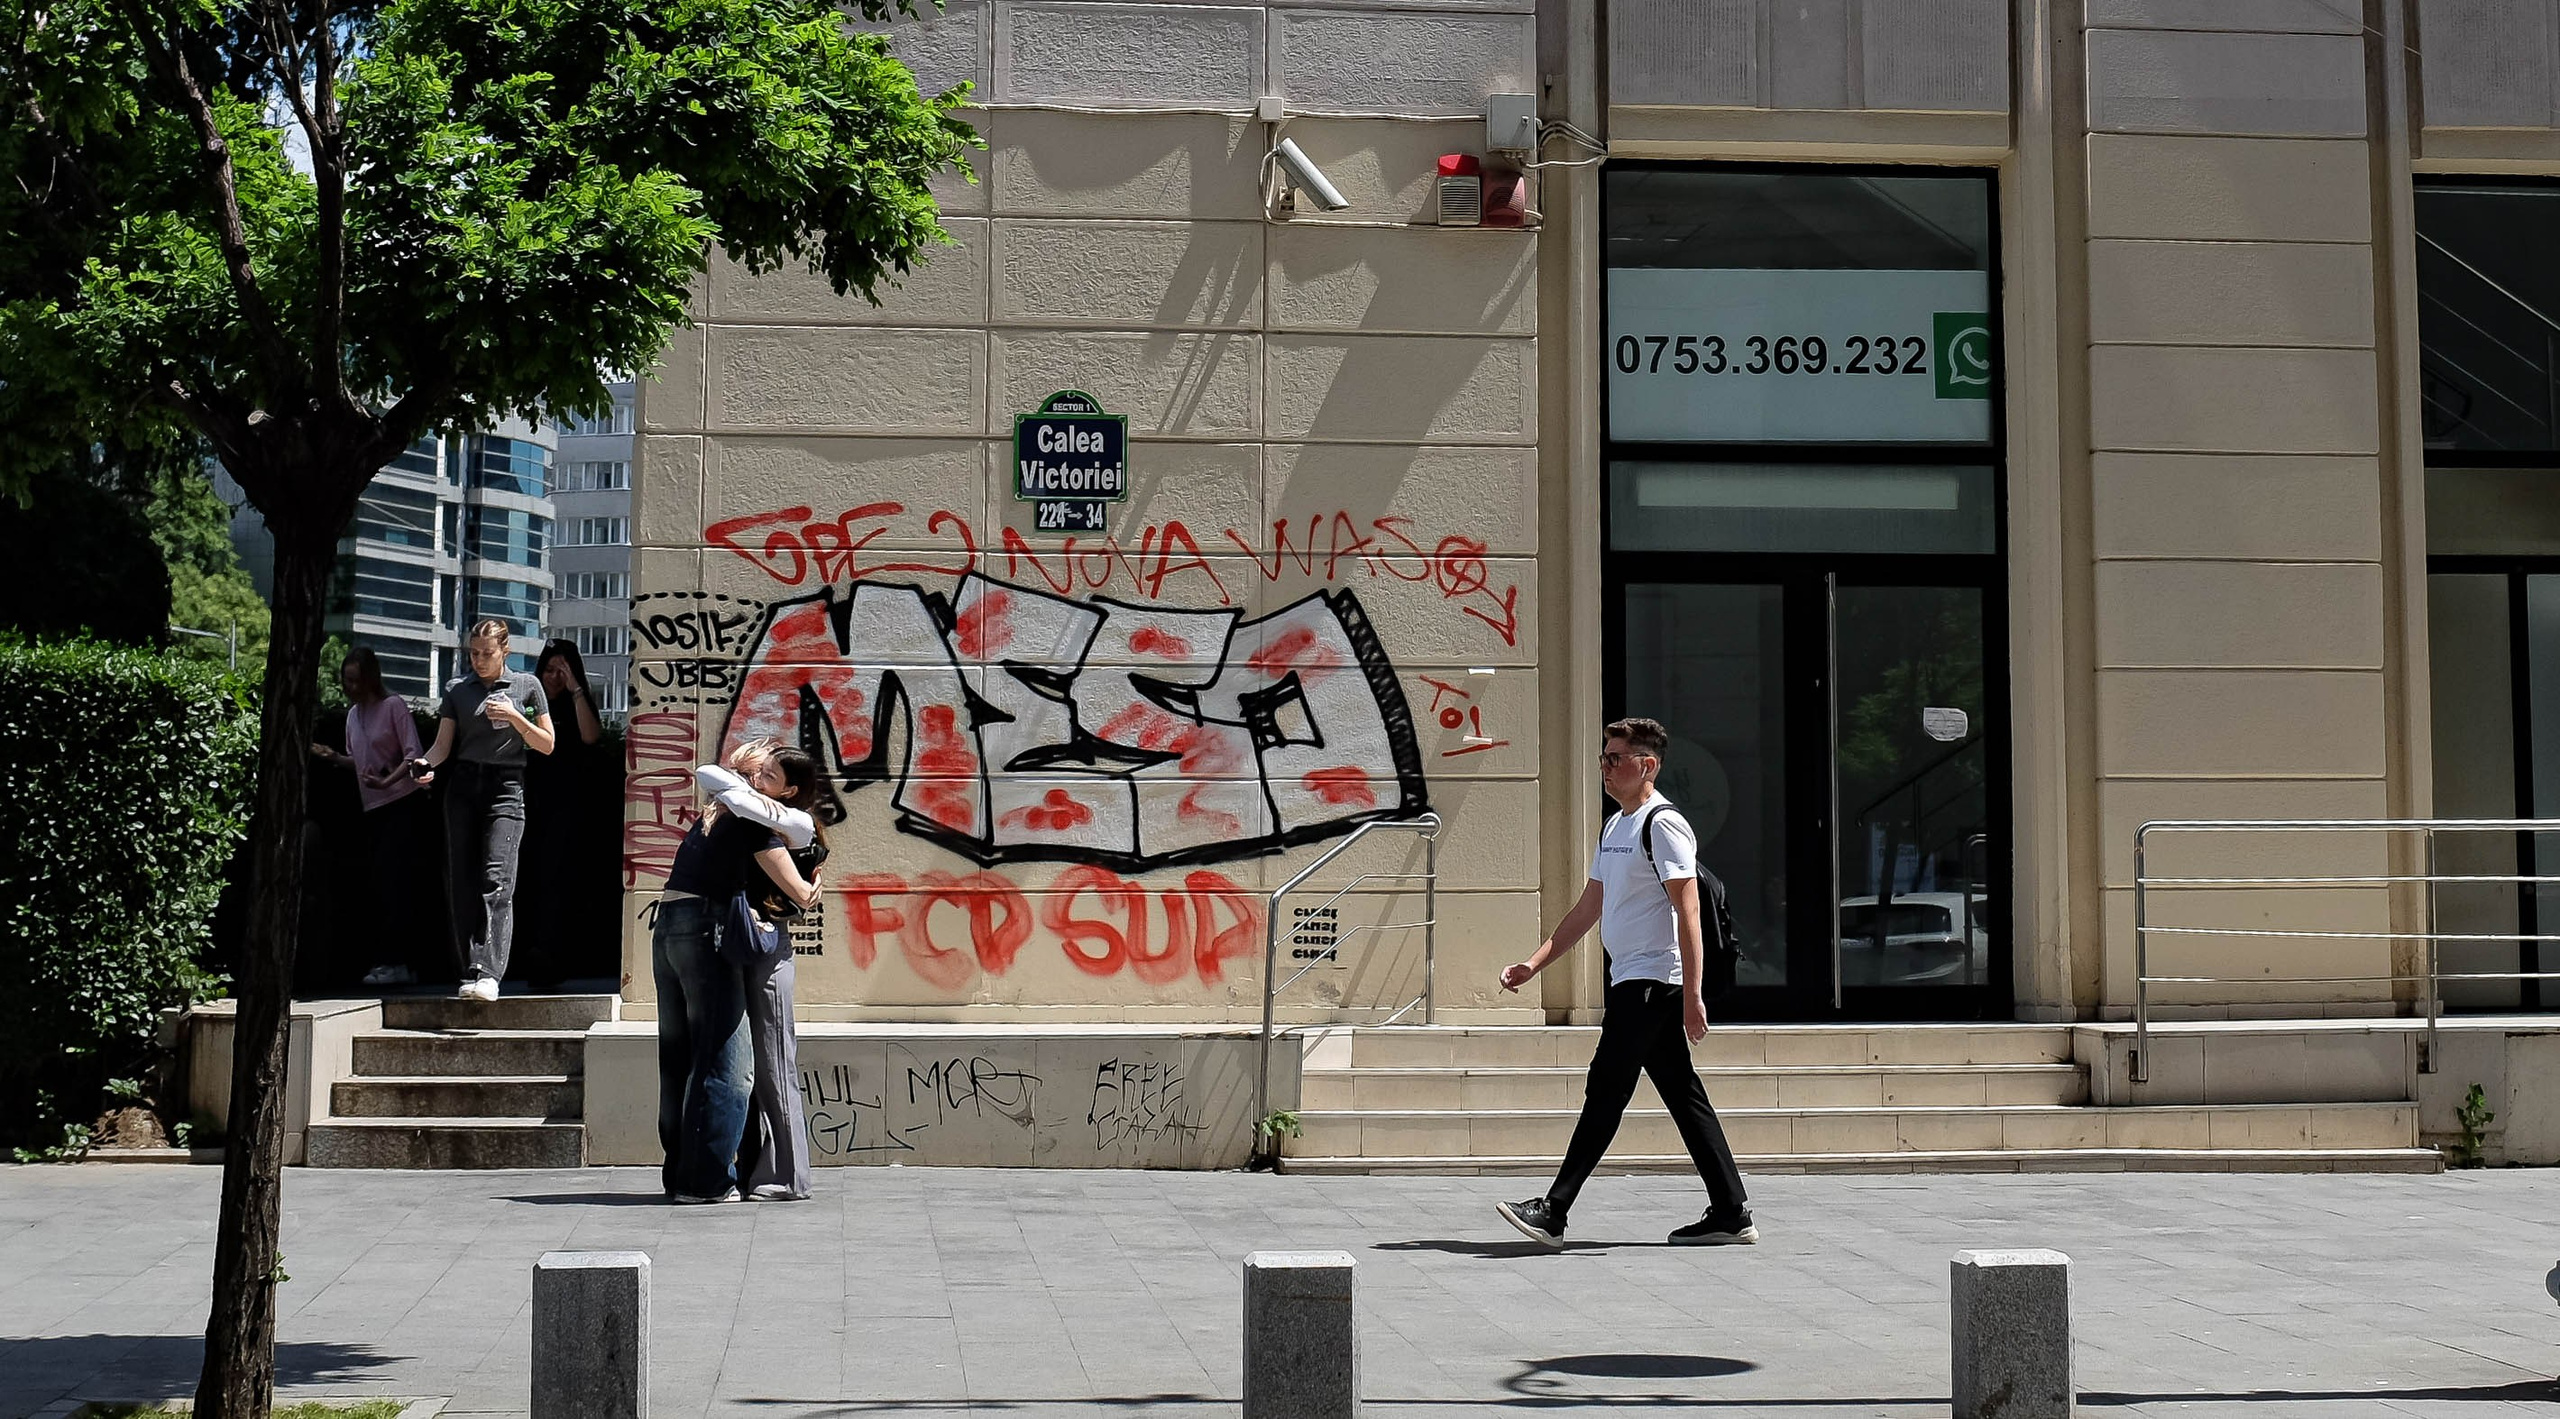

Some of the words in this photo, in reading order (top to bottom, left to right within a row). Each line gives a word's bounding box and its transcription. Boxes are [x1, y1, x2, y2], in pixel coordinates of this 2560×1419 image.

[1615, 335, 1928, 375] 0753.369.232
[1053, 403, 1084, 412] SECTOR
[1086, 403, 1091, 412] 1
[1037, 424, 1105, 453] Calea
[1020, 460, 1123, 491] Victoriei
[1086, 503, 1103, 528] 34
